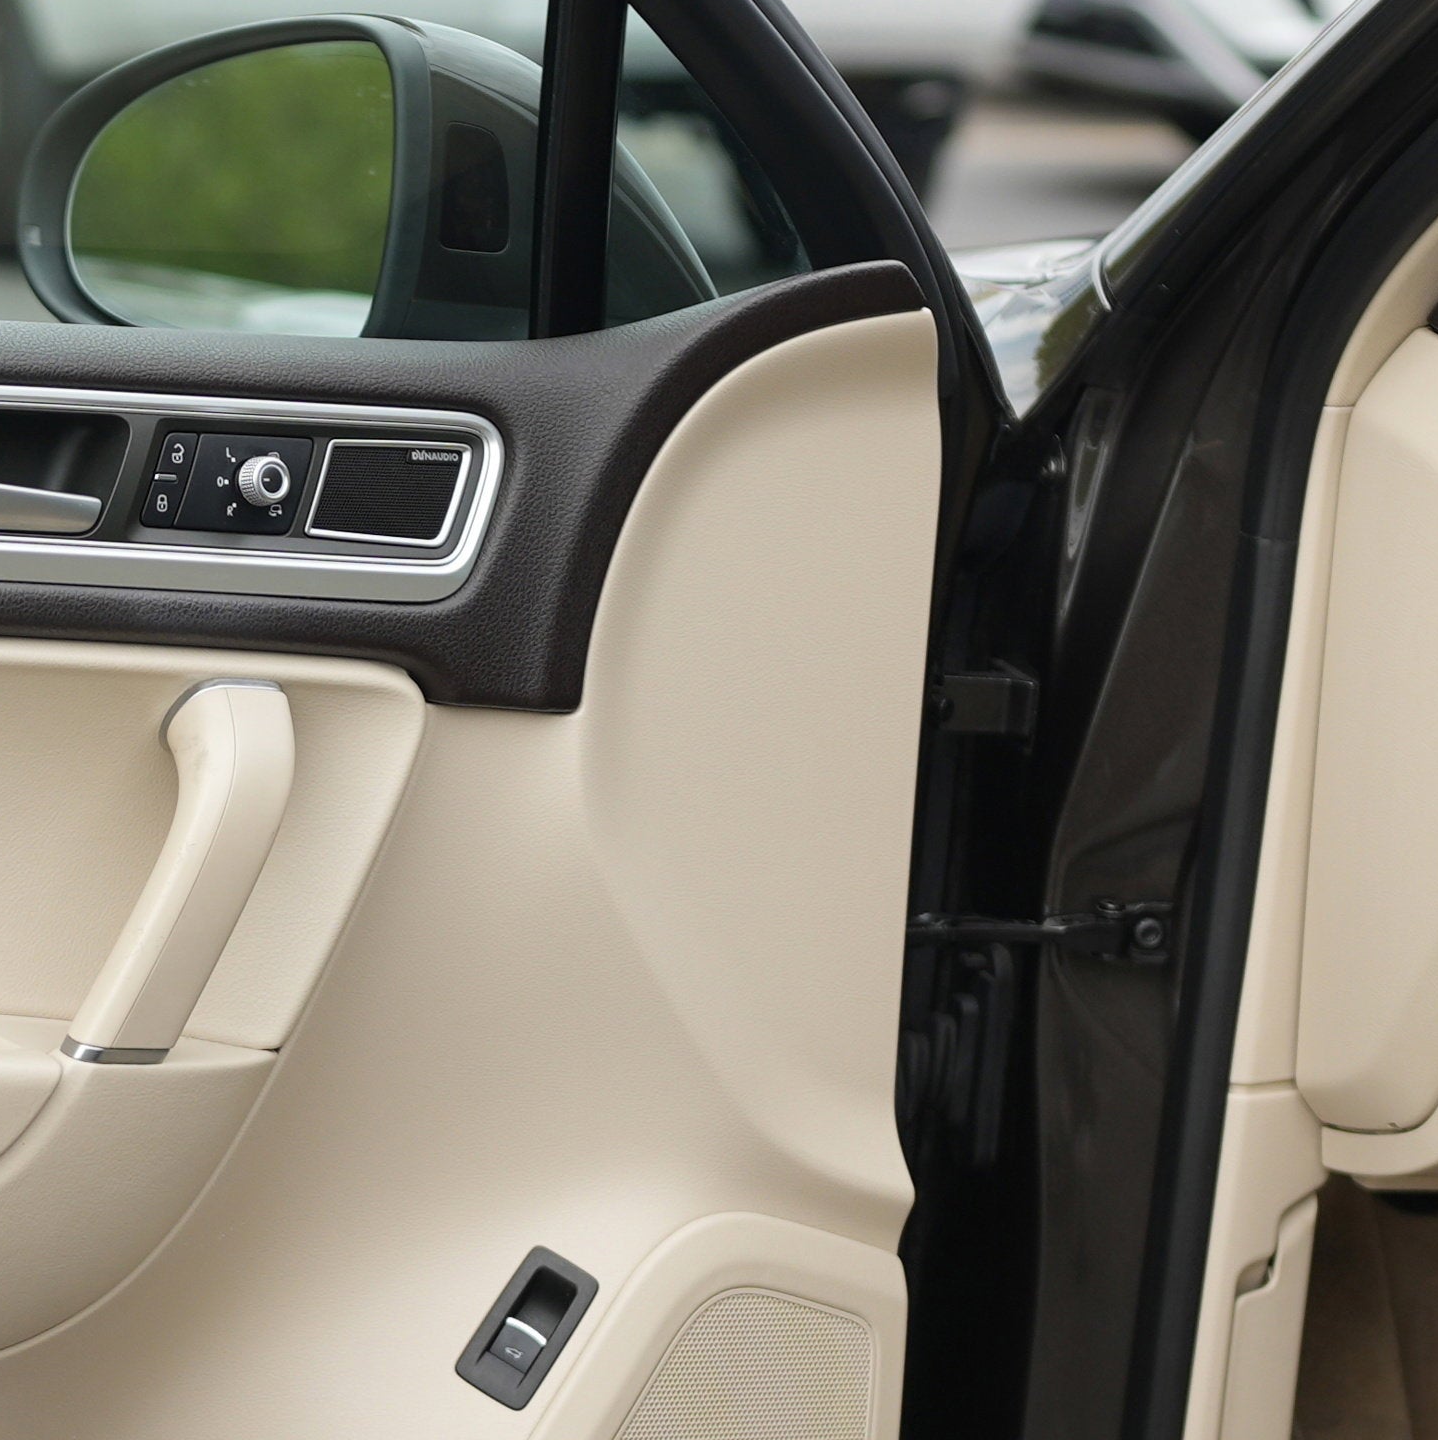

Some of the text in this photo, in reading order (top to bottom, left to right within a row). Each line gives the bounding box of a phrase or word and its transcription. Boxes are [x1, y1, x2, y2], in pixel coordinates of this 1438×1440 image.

[226, 447, 233, 460] L
[411, 449, 460, 462] DYNAUDIO
[227, 505, 234, 517] R
